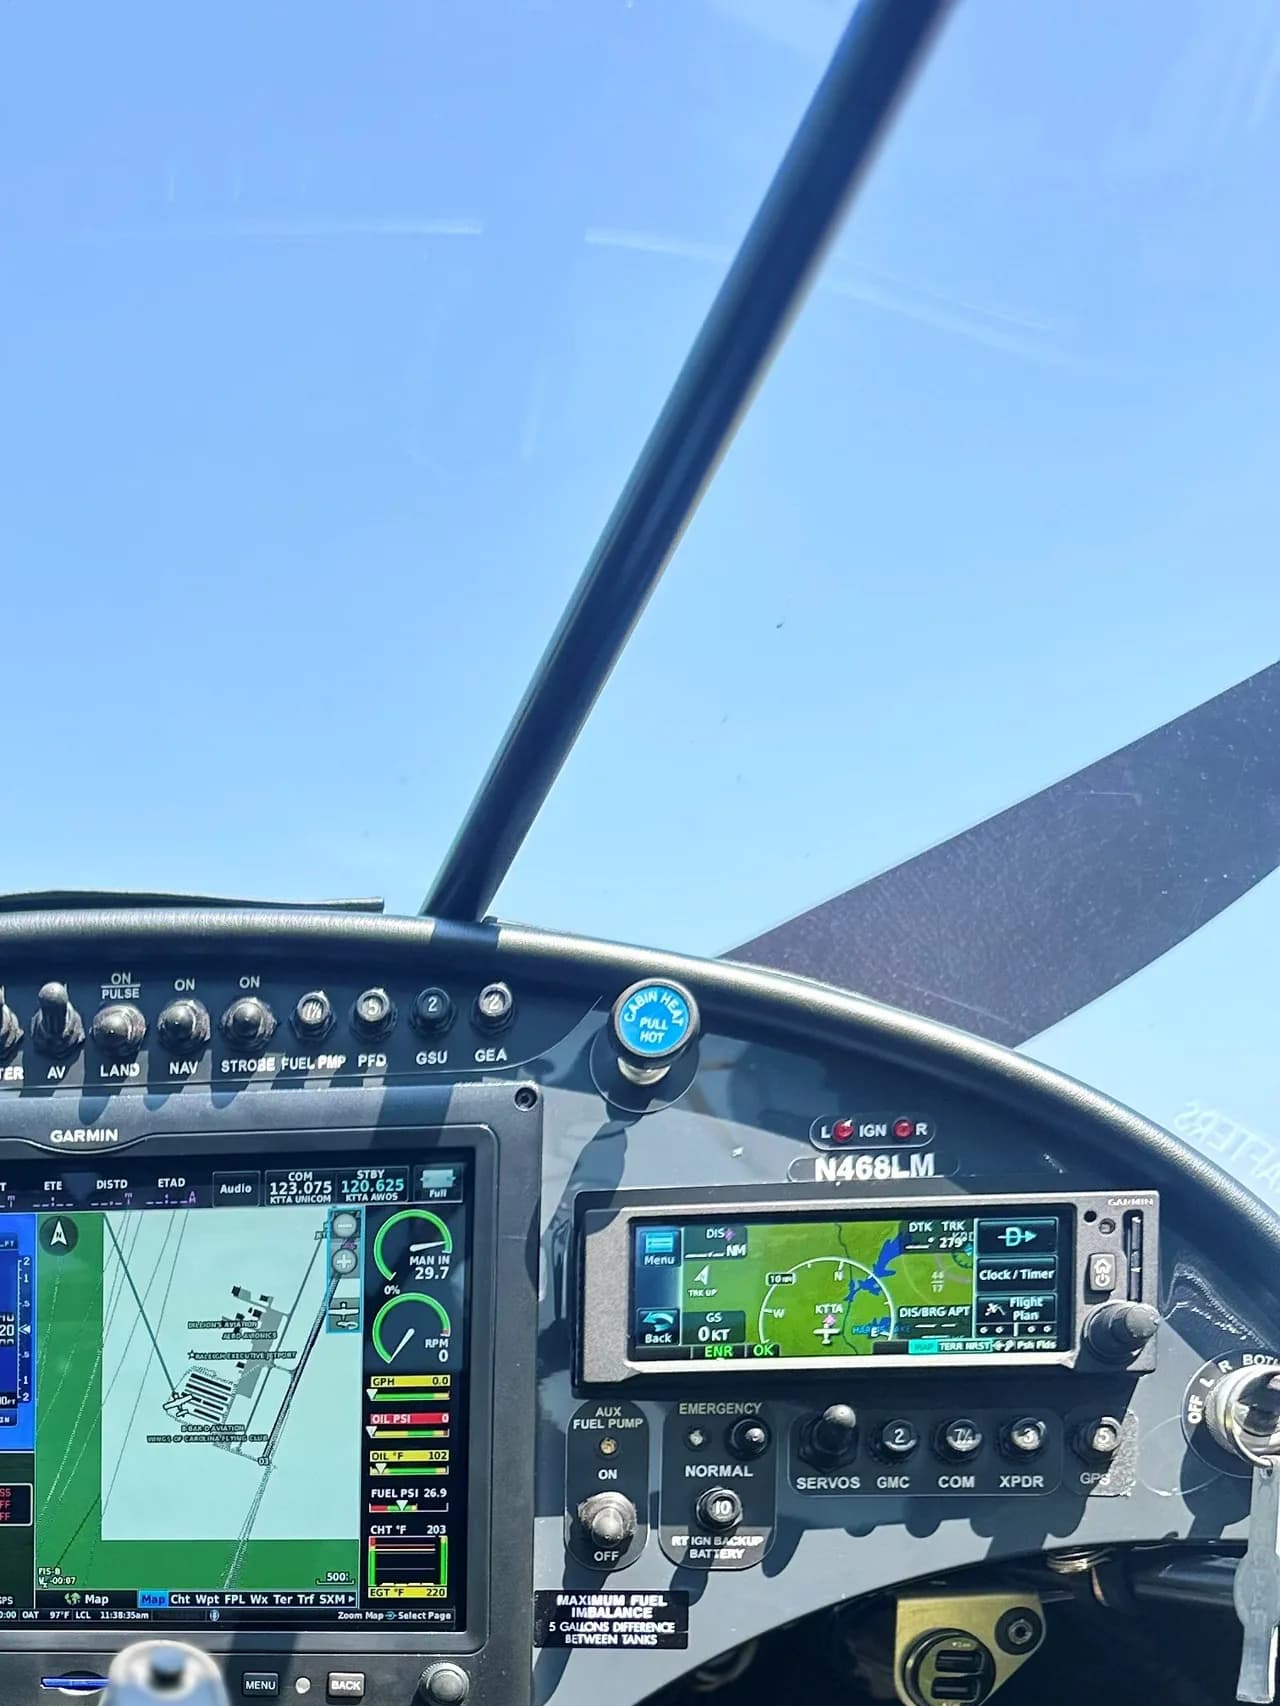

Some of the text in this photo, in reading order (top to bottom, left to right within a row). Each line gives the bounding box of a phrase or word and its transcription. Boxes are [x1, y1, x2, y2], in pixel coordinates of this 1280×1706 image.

[111, 973, 131, 985] ON
[174, 978, 195, 991] ON
[239, 976, 260, 988] ON
[101, 988, 140, 1000] PULSE
[624, 991, 684, 1026] CABIN HEAT
[640, 1017, 668, 1030] PULL
[640, 1031, 665, 1044] HOT
[358, 1054, 387, 1067] PFD
[416, 1050, 447, 1065] GSU
[474, 1048, 507, 1062] GEA
[169, 1061, 198, 1075] NAV
[221, 1057, 275, 1072] STROBE
[281, 1054, 346, 1070] FUEL PMP
[100, 1062, 140, 1077] LAND
[50, 1129, 118, 1143] GARMIN
[859, 1125, 887, 1137] IGN
[814, 1153, 935, 1181] N468LM
[288, 1172, 312, 1181] COM
[357, 1170, 385, 1180] STBY
[44, 1181, 62, 1191] ETE
[96, 1179, 128, 1189] DISTD
[158, 1178, 186, 1188] ETAD
[220, 1183, 252, 1194] Audio
[270, 1181, 332, 1195] 123.075
[341, 1179, 404, 1193] 120.625
[1108, 1198, 1154, 1206] GARMIN
[909, 1220, 965, 1232] DTK TRK
[410, 1255, 450, 1265] MAN IN
[644, 1255, 674, 1266] Menu
[415, 1267, 449, 1279] 29.7
[1010, 1297, 1042, 1309] Flight
[899, 1306, 970, 1318] DIS/BRG APT
[1013, 1310, 1039, 1321] Plan
[425, 1339, 448, 1348] RPM
[644, 1333, 671, 1344] Back
[704, 1345, 733, 1357] ENR
[753, 1344, 773, 1356] OK
[940, 1342, 963, 1351] TERR
[595, 1407, 621, 1417] AUX
[679, 1403, 762, 1415] EMERGENCY
[1188, 1394, 1203, 1424] OFF
[573, 1418, 643, 1429] FUEL PUMP
[598, 1469, 617, 1480] ON
[685, 1465, 754, 1477] NORMAL
[796, 1476, 860, 1489] SERVOS
[877, 1475, 909, 1489] GMC
[938, 1475, 975, 1488] COM
[1000, 1475, 1044, 1488] XPDR
[1080, 1472, 1110, 1485] GPS
[371, 1488, 447, 1498] FUEL PSI 26.9
[672, 1536, 764, 1547] RT IGN BACKUP
[593, 1551, 619, 1562] OFF
[690, 1549, 745, 1559] BATTERY
[85, 1595, 109, 1606] Map
[556, 1595, 667, 1606] MAXIMUM FUEL
[571, 1607, 653, 1619] IMBALANCE
[549, 1622, 675, 1633] 5 GALLONS DIFFERENCE
[565, 1634, 658, 1645] BETWEEN TANKS
[245, 1680, 276, 1689] MENU
[331, 1680, 361, 1690] BACK
